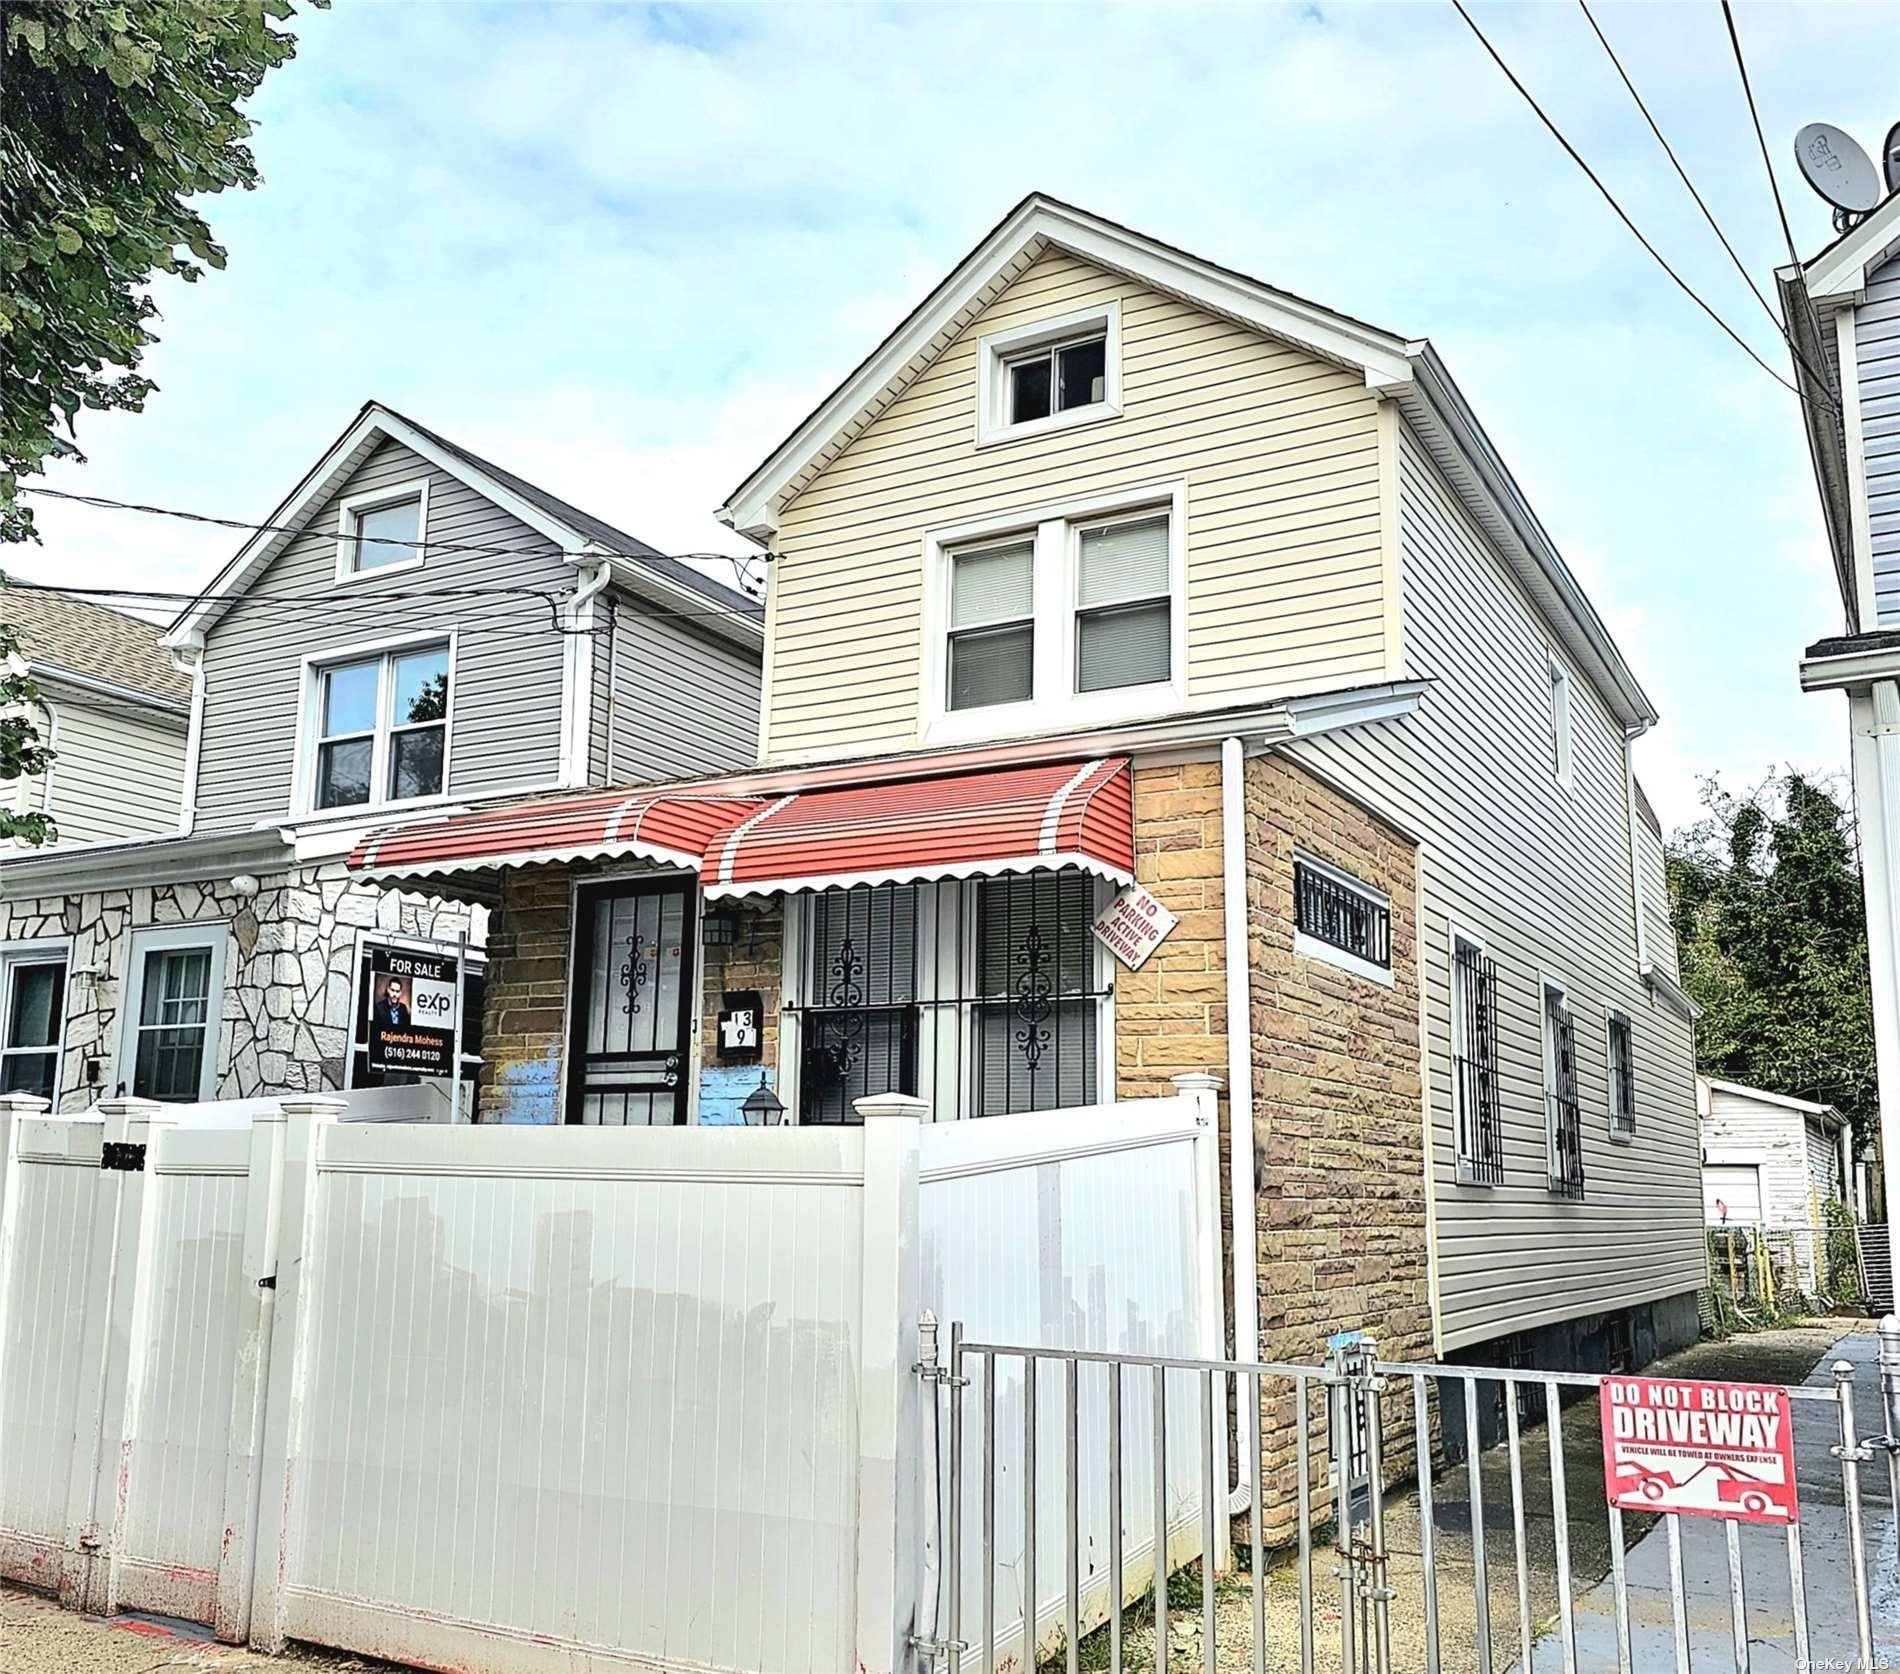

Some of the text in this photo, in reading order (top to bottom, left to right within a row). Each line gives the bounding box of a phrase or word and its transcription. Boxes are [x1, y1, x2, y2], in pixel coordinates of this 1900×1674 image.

[1136, 896, 1157, 917] NO
[1114, 898, 1159, 941] PARKING
[1095, 921, 1140, 962] DRIVEWAY
[1111, 917, 1142, 946] ACTIVE
[390, 958, 441, 978] FOR SALE
[417, 993, 450, 1016] exp
[380, 1031, 443, 1046] Rajendra Mohess
[384, 1046, 440, 1061] (516) 244 0120
[1610, 1383, 1779, 1414] DO NOT BLOCK
[1613, 1406, 1780, 1449] DRIVEWAY
[1621, 1446, 1777, 1464] VEHICLE WILL BE TOWED AT OWNERS EXPENSE
